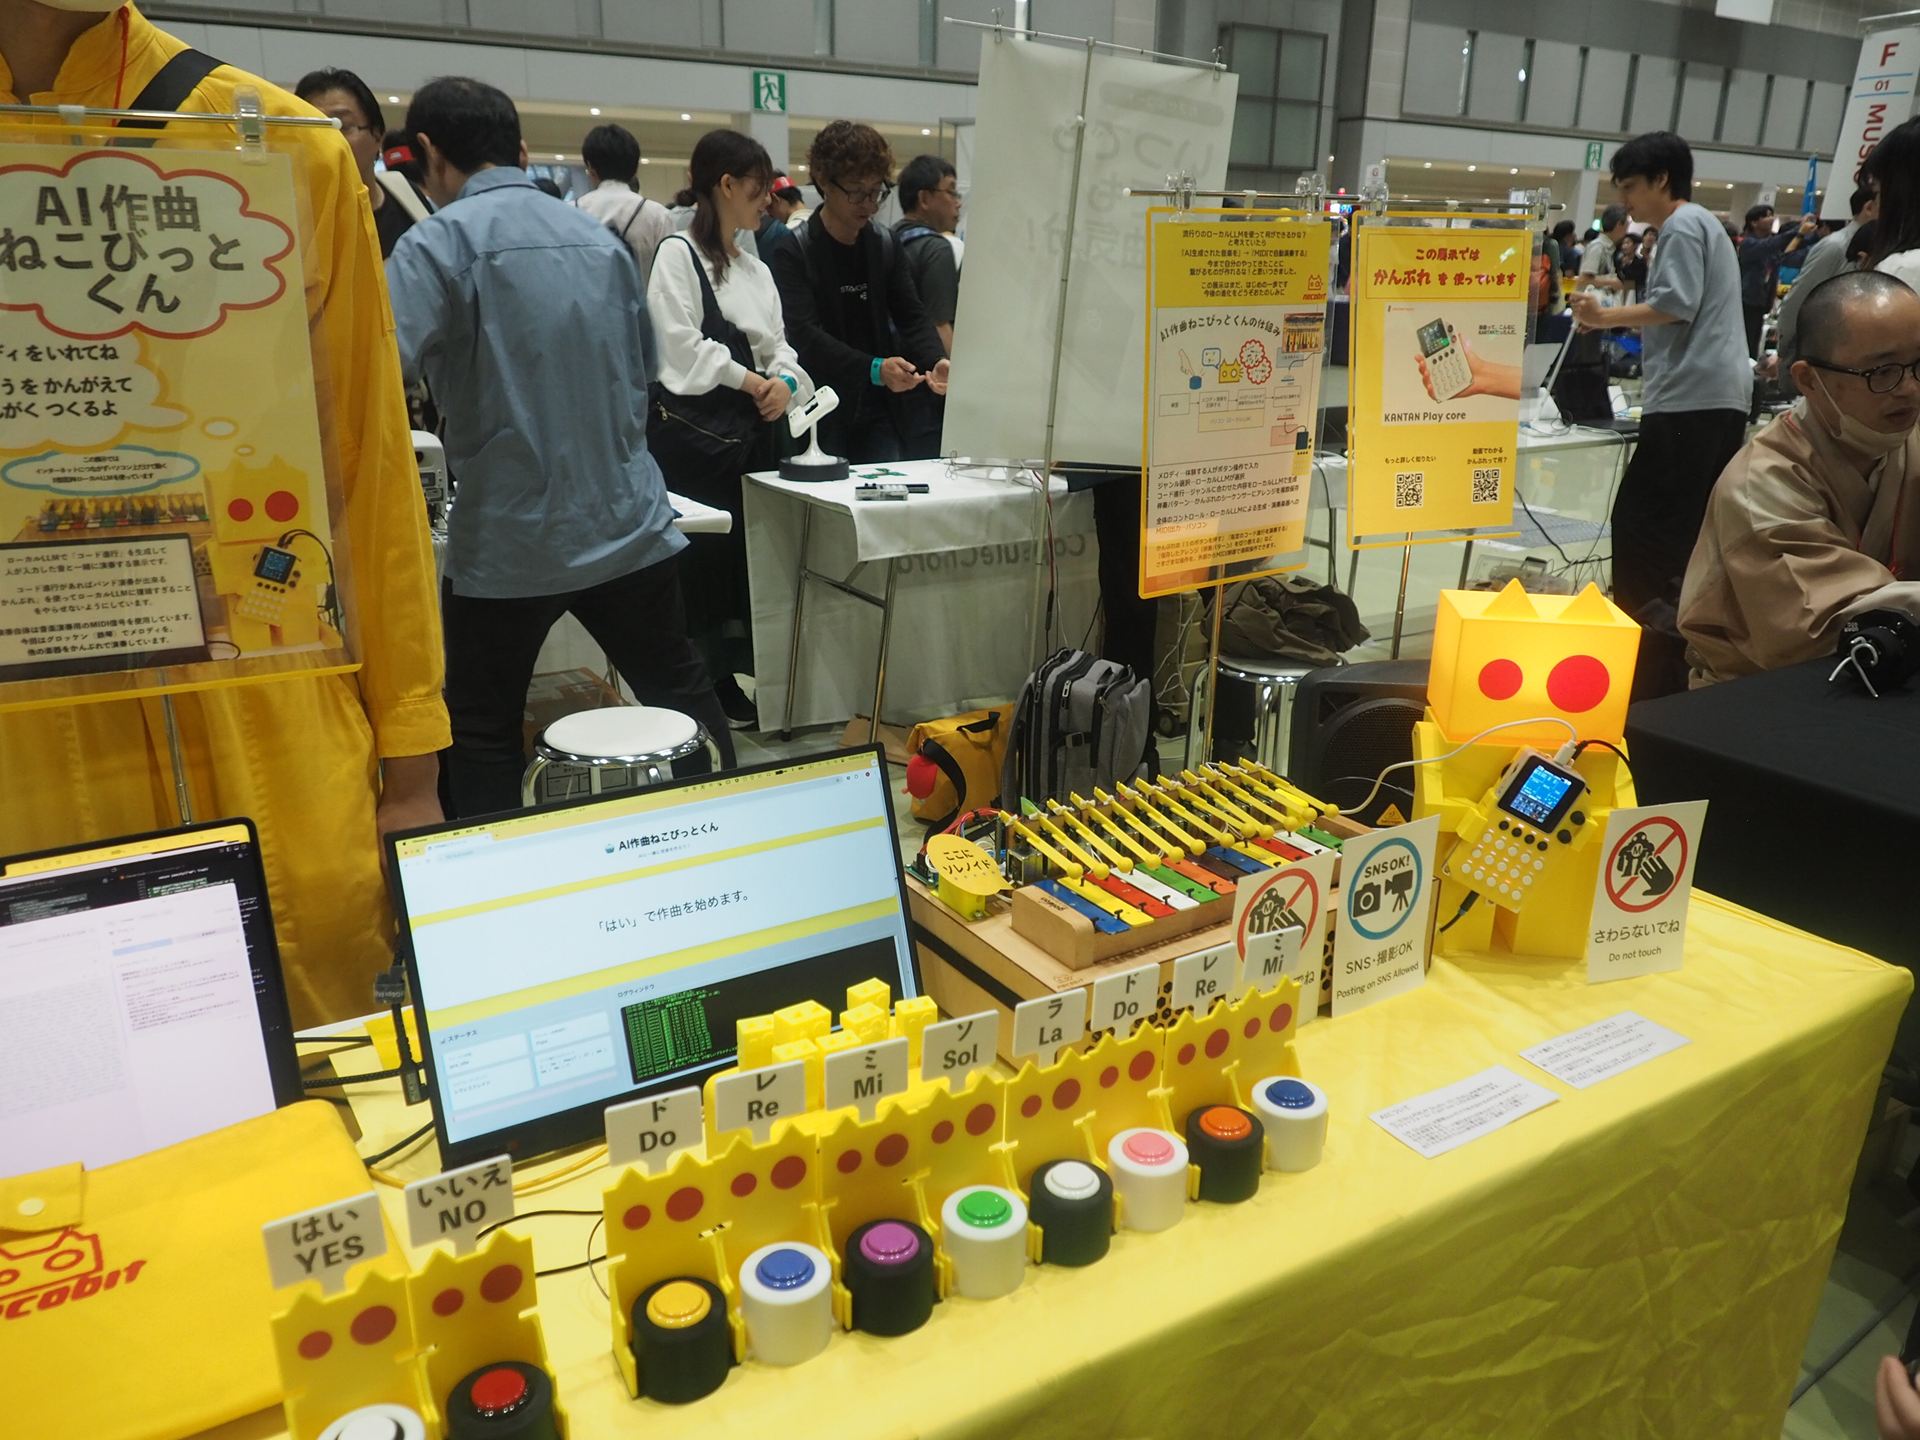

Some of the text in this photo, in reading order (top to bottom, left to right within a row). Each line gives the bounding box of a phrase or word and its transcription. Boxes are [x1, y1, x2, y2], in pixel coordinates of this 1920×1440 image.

[1879, 42, 1901, 67] F
[1873, 79, 1891, 92] 01
[36, 182, 202, 233] AI作曲
[0, 226, 245, 273] ねこびっと
[1415, 247, 1481, 261] この展示では
[1373, 267, 1431, 286] かんぷれ
[1453, 270, 1518, 287] 使っています
[86, 272, 181, 315] くん
[1384, 410, 1467, 425] KANTAN Play core
[618, 821, 720, 853] AI作曲ねこびっとくん
[943, 848, 975, 862] ここに
[941, 858, 991, 876] ソレノイド
[1594, 919, 1680, 944] さわらないでね
[1203, 954, 1218, 972] レ
[1262, 955, 1285, 976] Mi
[1608, 945, 1662, 963] Do not touch
[1125, 974, 1137, 994] ド
[1195, 977, 1218, 998] Re
[1336, 960, 1420, 1001] Posting on SNS Allowed
[1047, 999, 1063, 1018] ラ
[1112, 999, 1140, 1021] Do
[956, 1019, 975, 1041] ソ
[1038, 1024, 1064, 1047] La
[942, 1046, 980, 1070] Sol
[755, 1072, 778, 1092] レ
[853, 1072, 885, 1099] Mi
[650, 1099, 668, 1123] ド
[747, 1099, 780, 1122] Re
[638, 1129, 677, 1154] Do
[416, 1163, 509, 1210] いいえ
[290, 1207, 361, 1247] はい
[438, 1199, 487, 1235] NO
[293, 1235, 365, 1275] YES
